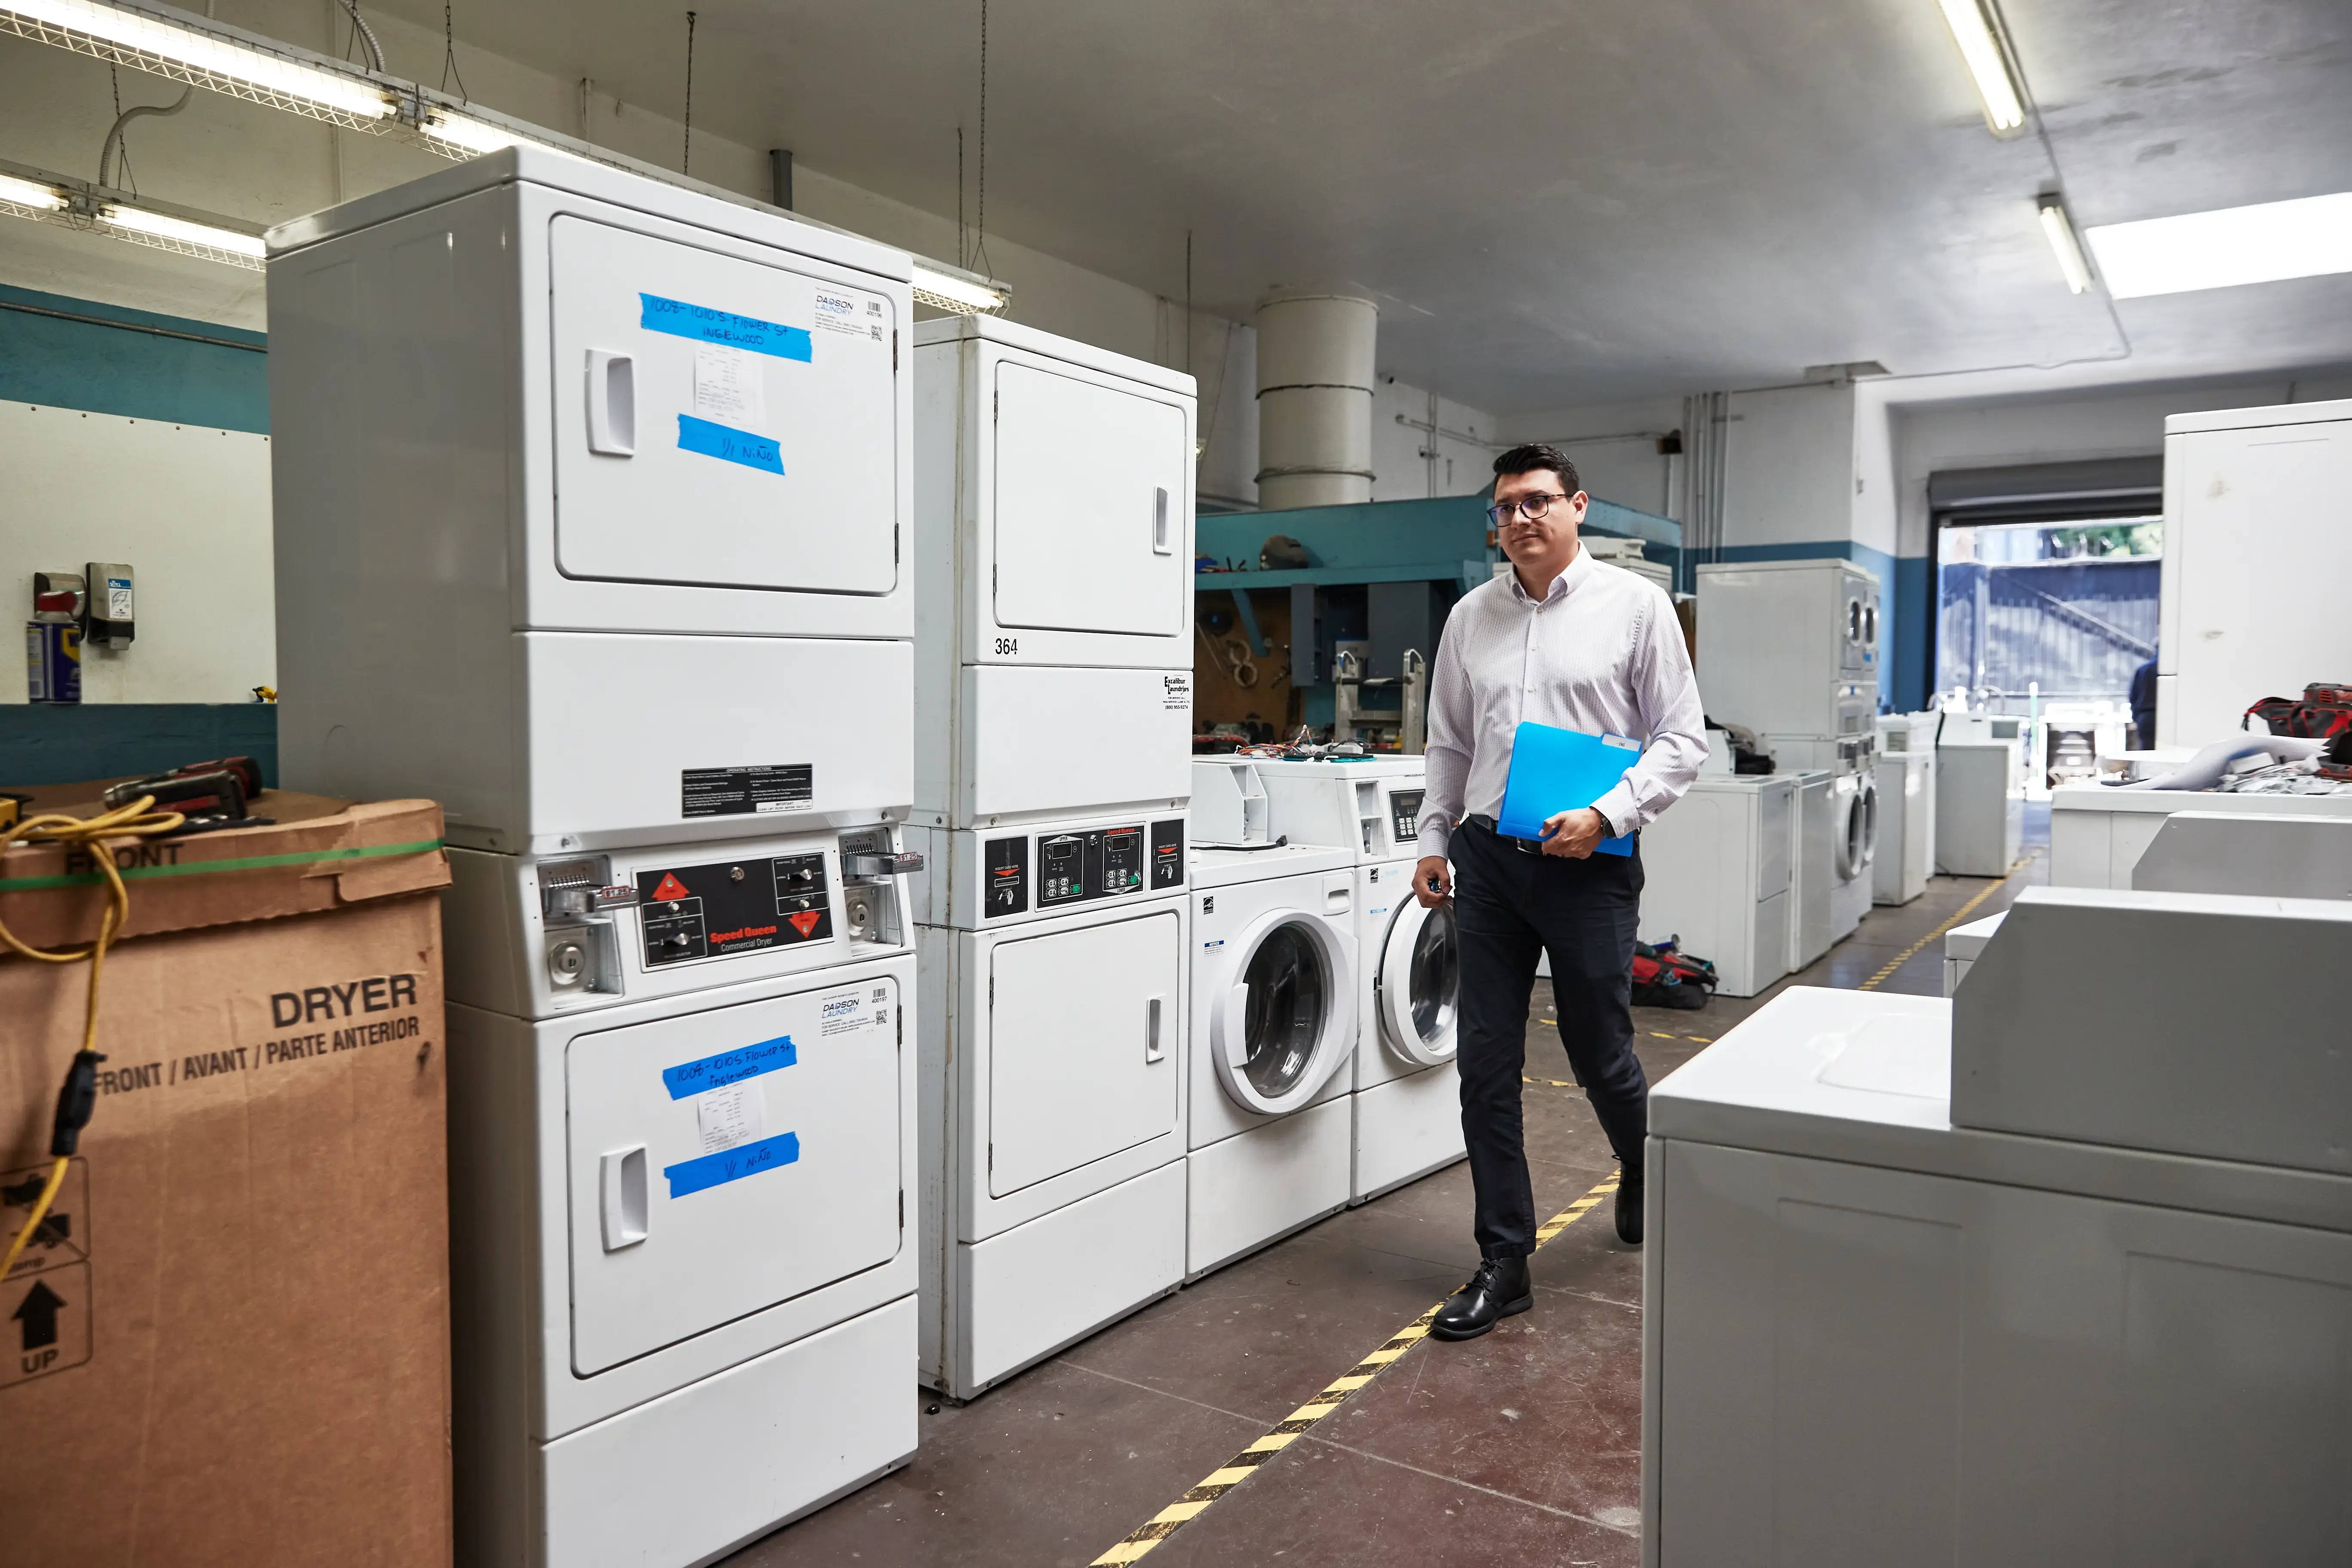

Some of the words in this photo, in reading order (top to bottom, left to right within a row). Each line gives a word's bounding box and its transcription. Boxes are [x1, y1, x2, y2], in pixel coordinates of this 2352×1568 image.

[816, 295, 854, 309] DADSON
[815, 303, 852, 316] LAUNDRY
[867, 310, 882, 318] 400196
[995, 638, 1017, 655] 364
[1165, 676, 1185, 687] Excalibur
[1168, 684, 1189, 695] Laundries
[606, 888, 628, 897] $1.25
[710, 929, 744, 944] Speed
[744, 925, 777, 937] Queen
[721, 939, 756, 952] Commercial
[757, 937, 773, 948] Dryer
[271, 974, 416, 1028] DRYER
[823, 998, 859, 1011] DADSON
[822, 1006, 858, 1018] LAUNDRY
[183, 1047, 248, 1081] AVANT
[266, 1033, 327, 1065] PARTE
[333, 1016, 420, 1052] ANTERIOR
[23, 1348, 59, 1373] UP
